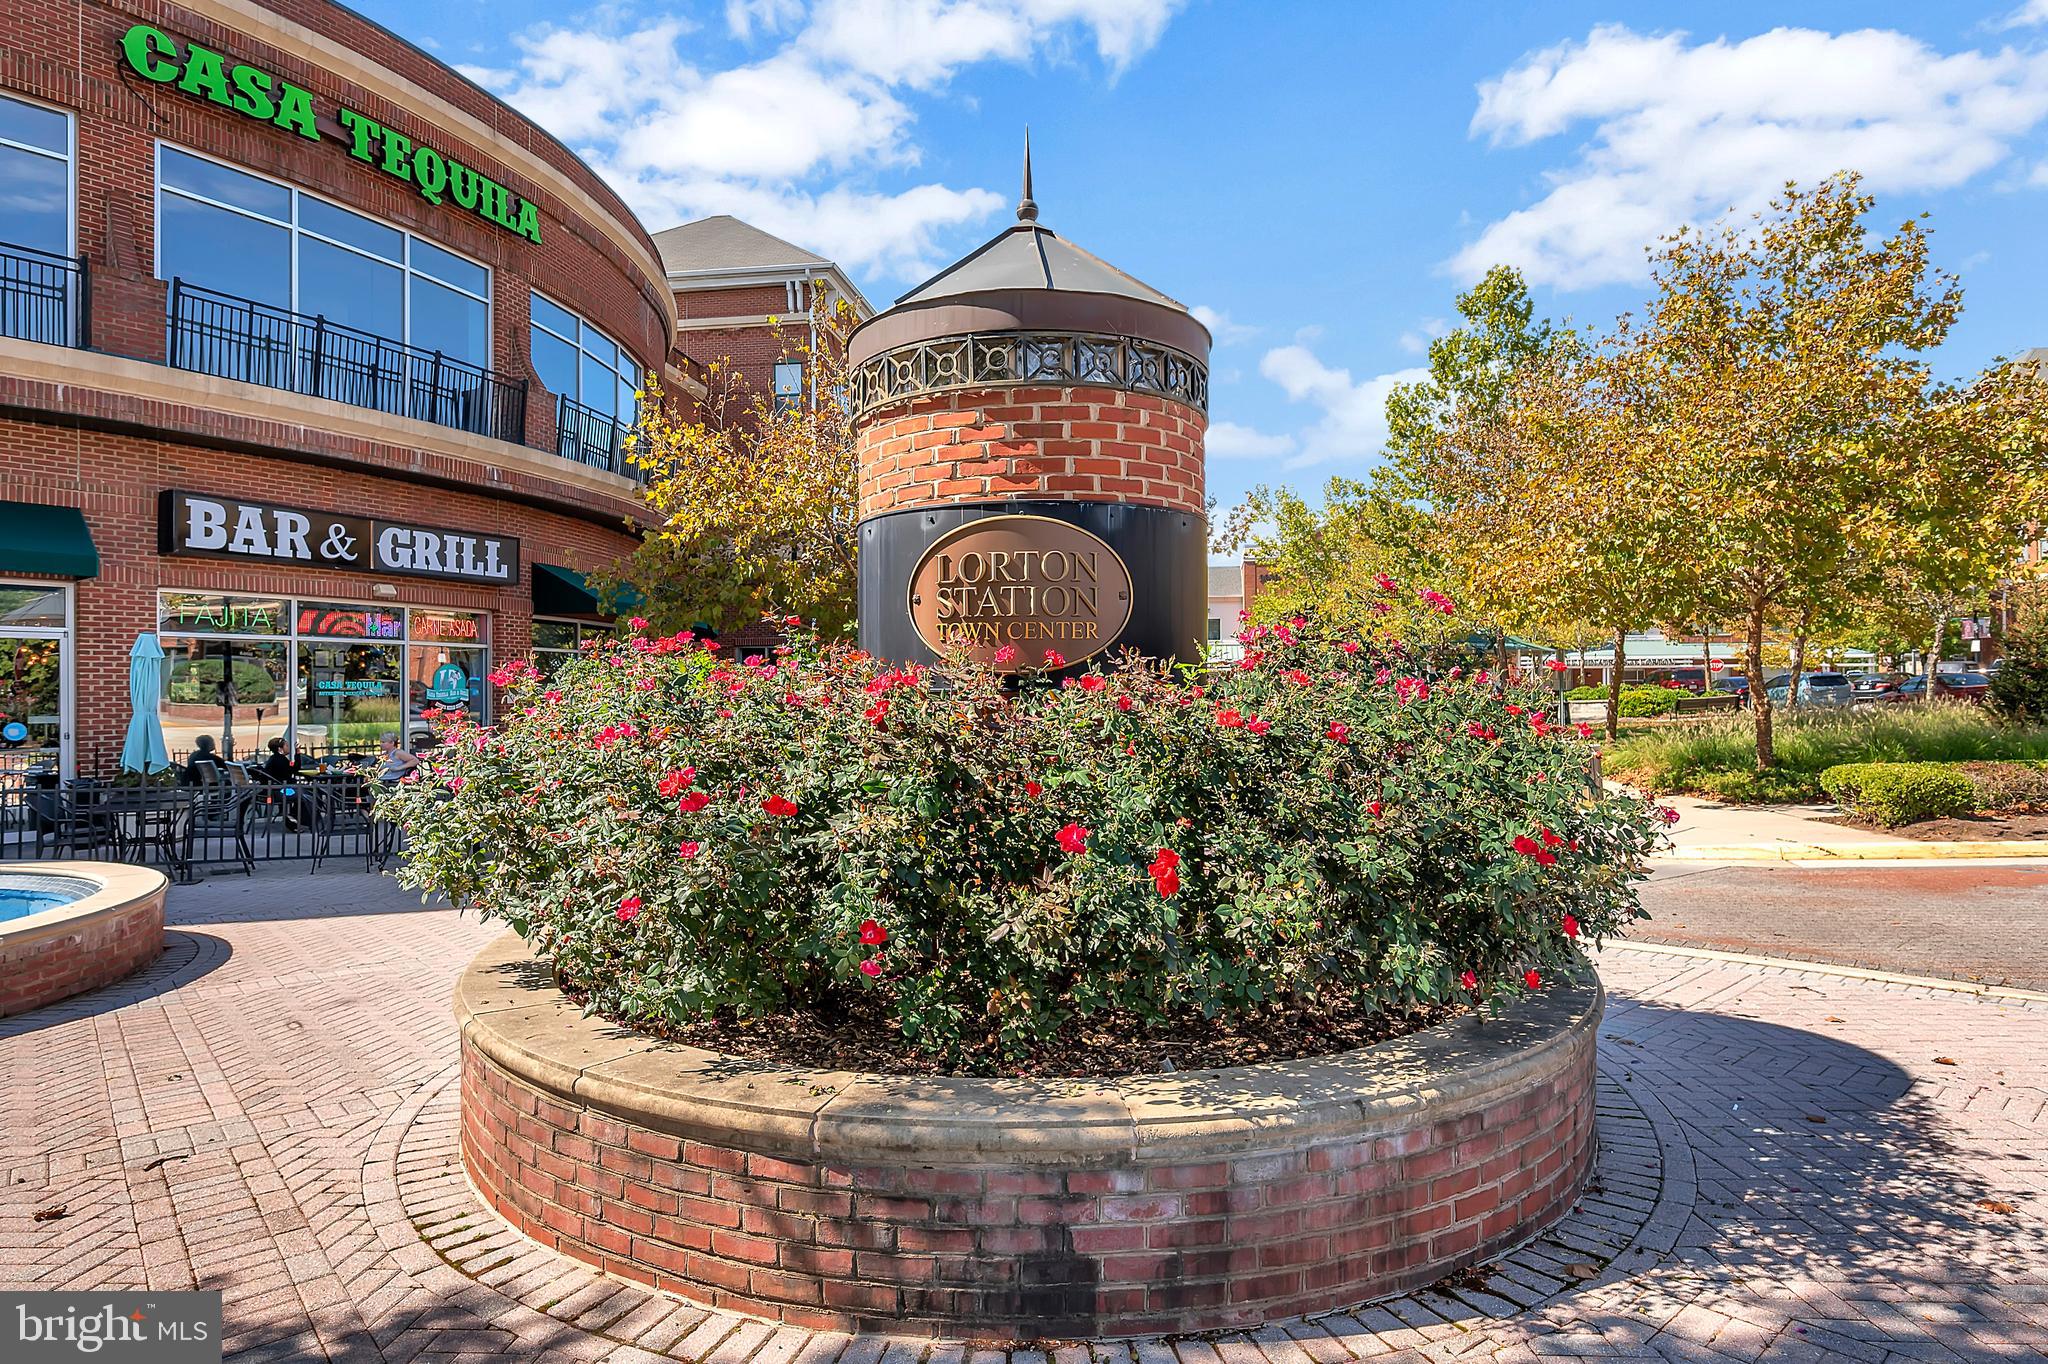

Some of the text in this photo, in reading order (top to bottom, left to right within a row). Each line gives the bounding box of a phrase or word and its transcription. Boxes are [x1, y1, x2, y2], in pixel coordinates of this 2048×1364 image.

[118, 25, 542, 245] CASA TEQUILA
[185, 498, 508, 578] BAR & GRILL
[935, 551, 1100, 619] LORTON STATION
[180, 603, 271, 628] FAJITA
[414, 616, 479, 638] CARNE ASADA
[936, 622, 1100, 641] TOWN CENTER
[319, 681, 382, 690] CASA TEQUILA
